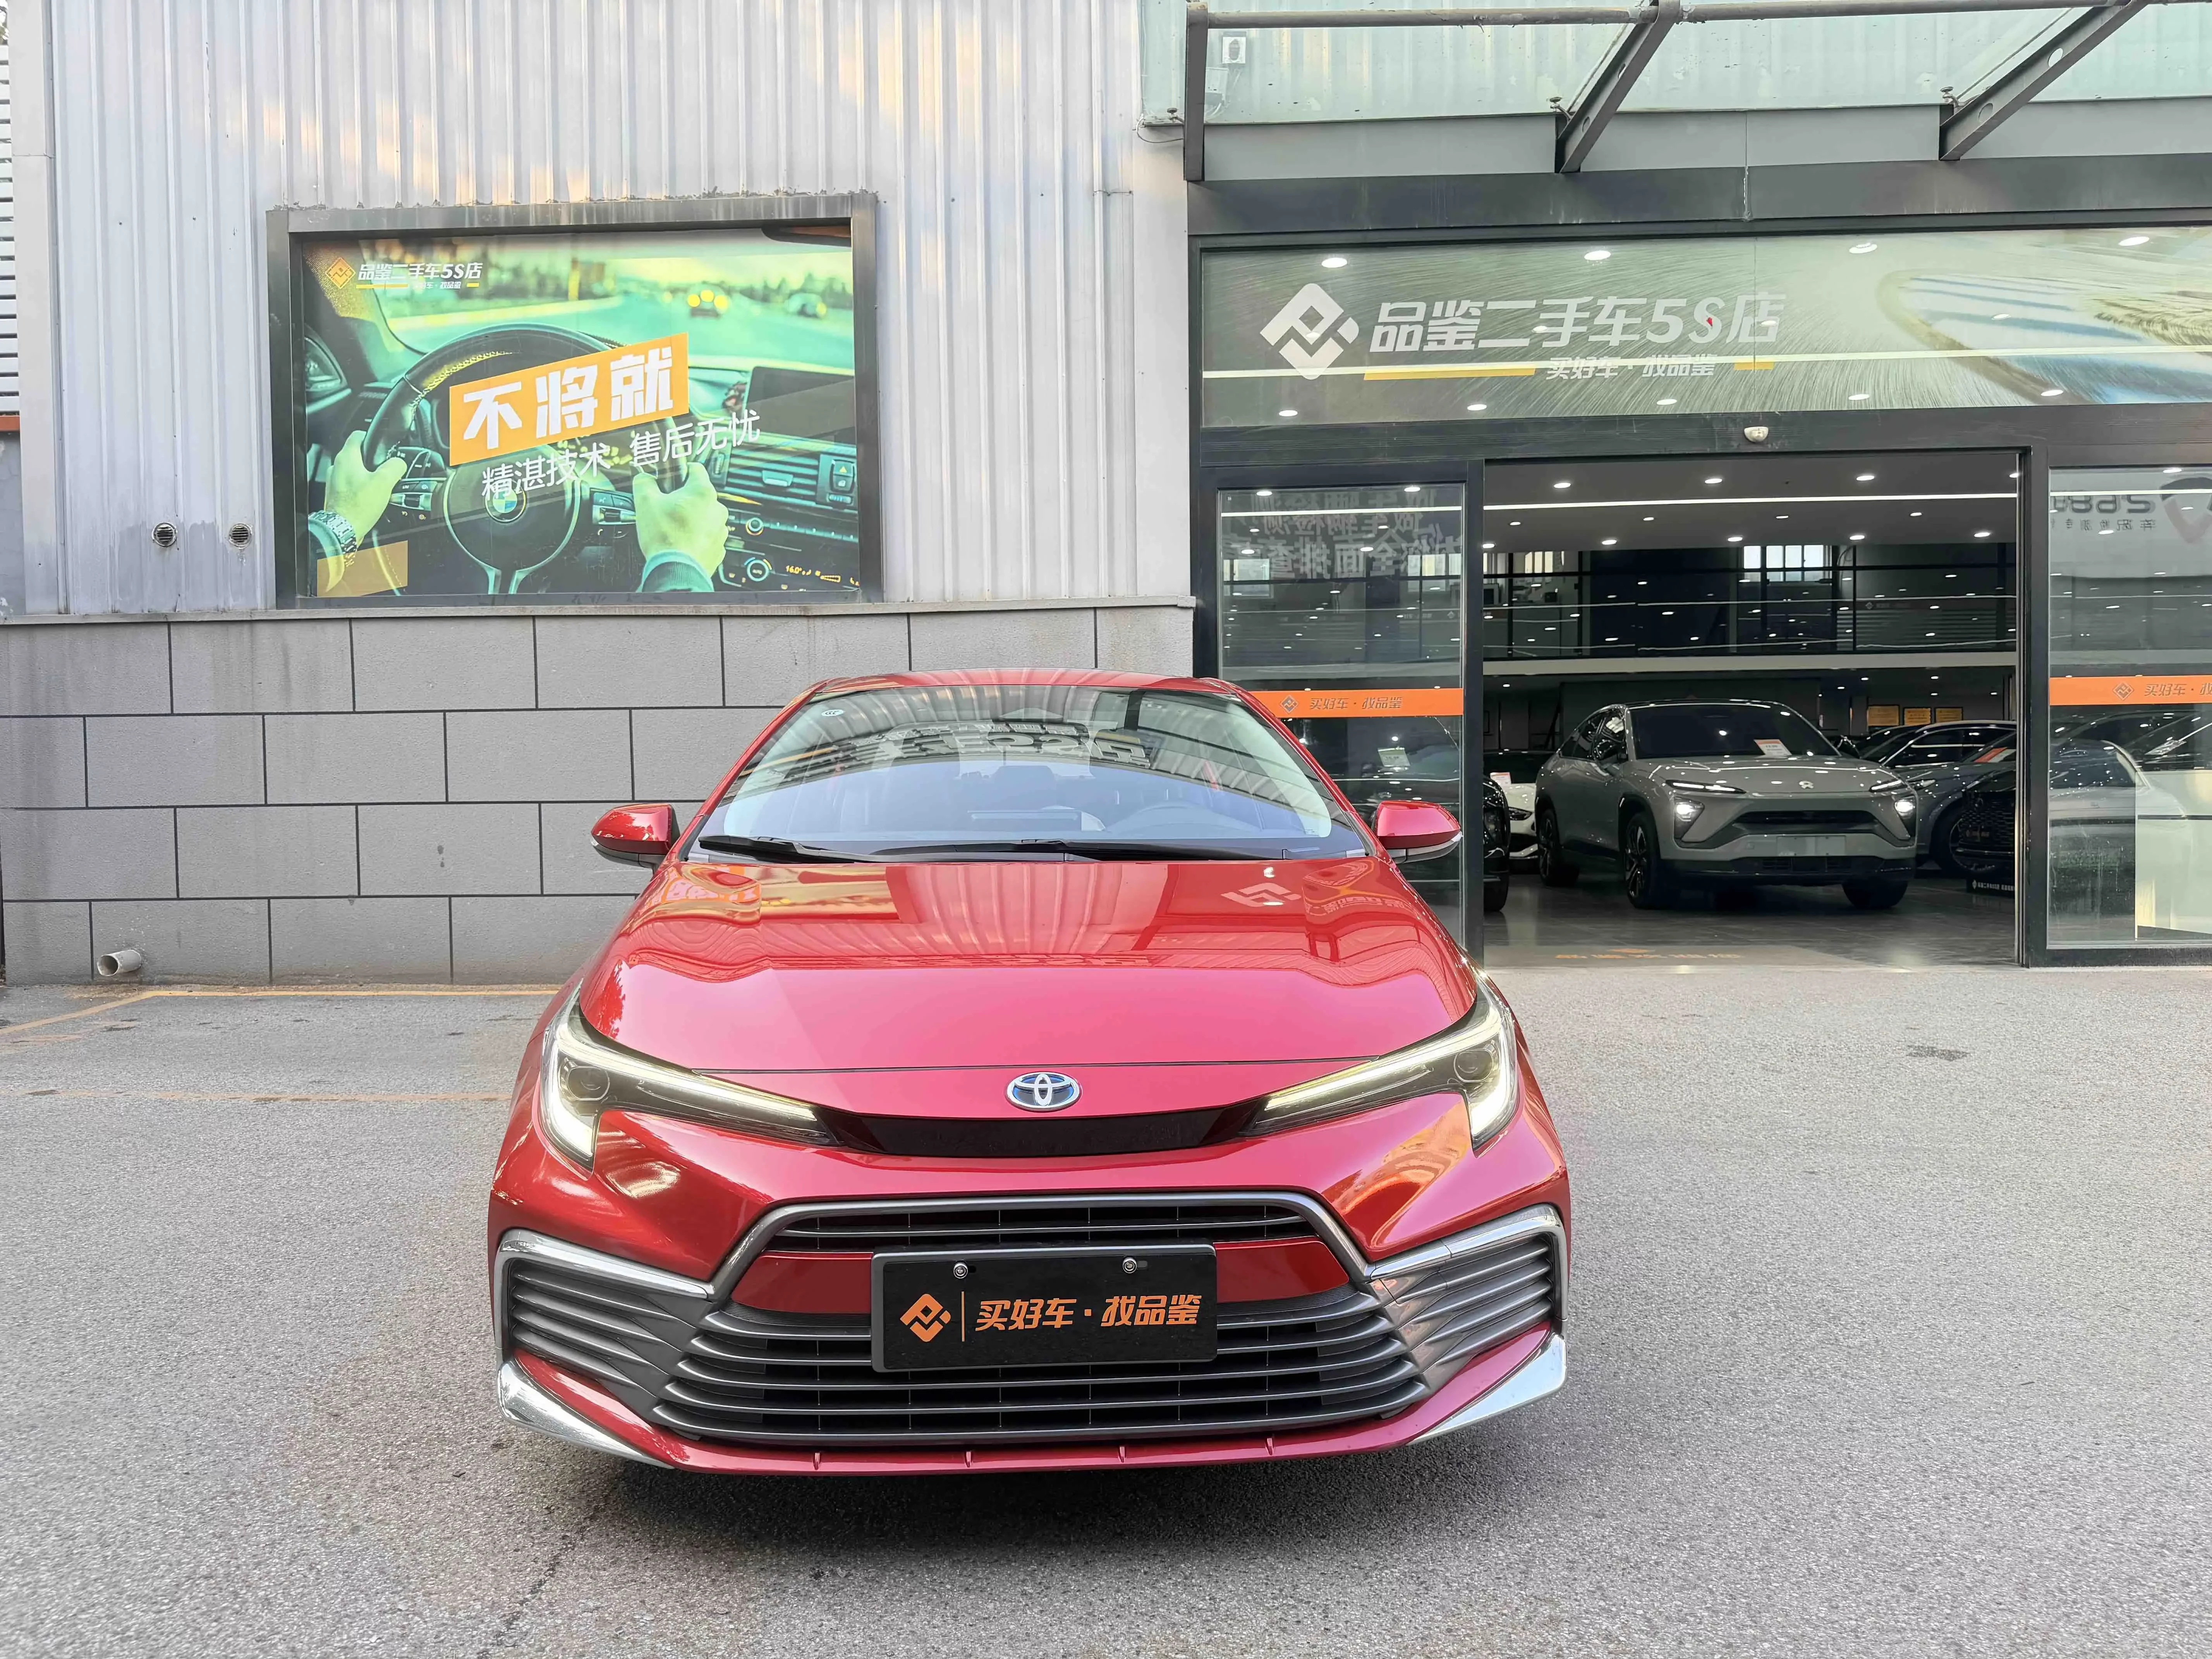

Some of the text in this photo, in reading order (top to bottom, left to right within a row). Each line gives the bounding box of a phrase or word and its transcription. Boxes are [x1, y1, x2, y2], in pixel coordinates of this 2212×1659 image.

[358, 262, 483, 280] 品鉴二手车5S店
[1370, 292, 1786, 353] 品鉴二手车5S店
[463, 346, 673, 449] 不将就
[482, 409, 761, 500] 精湛技术 售后无忧
[975, 1294, 1202, 1331] 买好车·找品鉴
